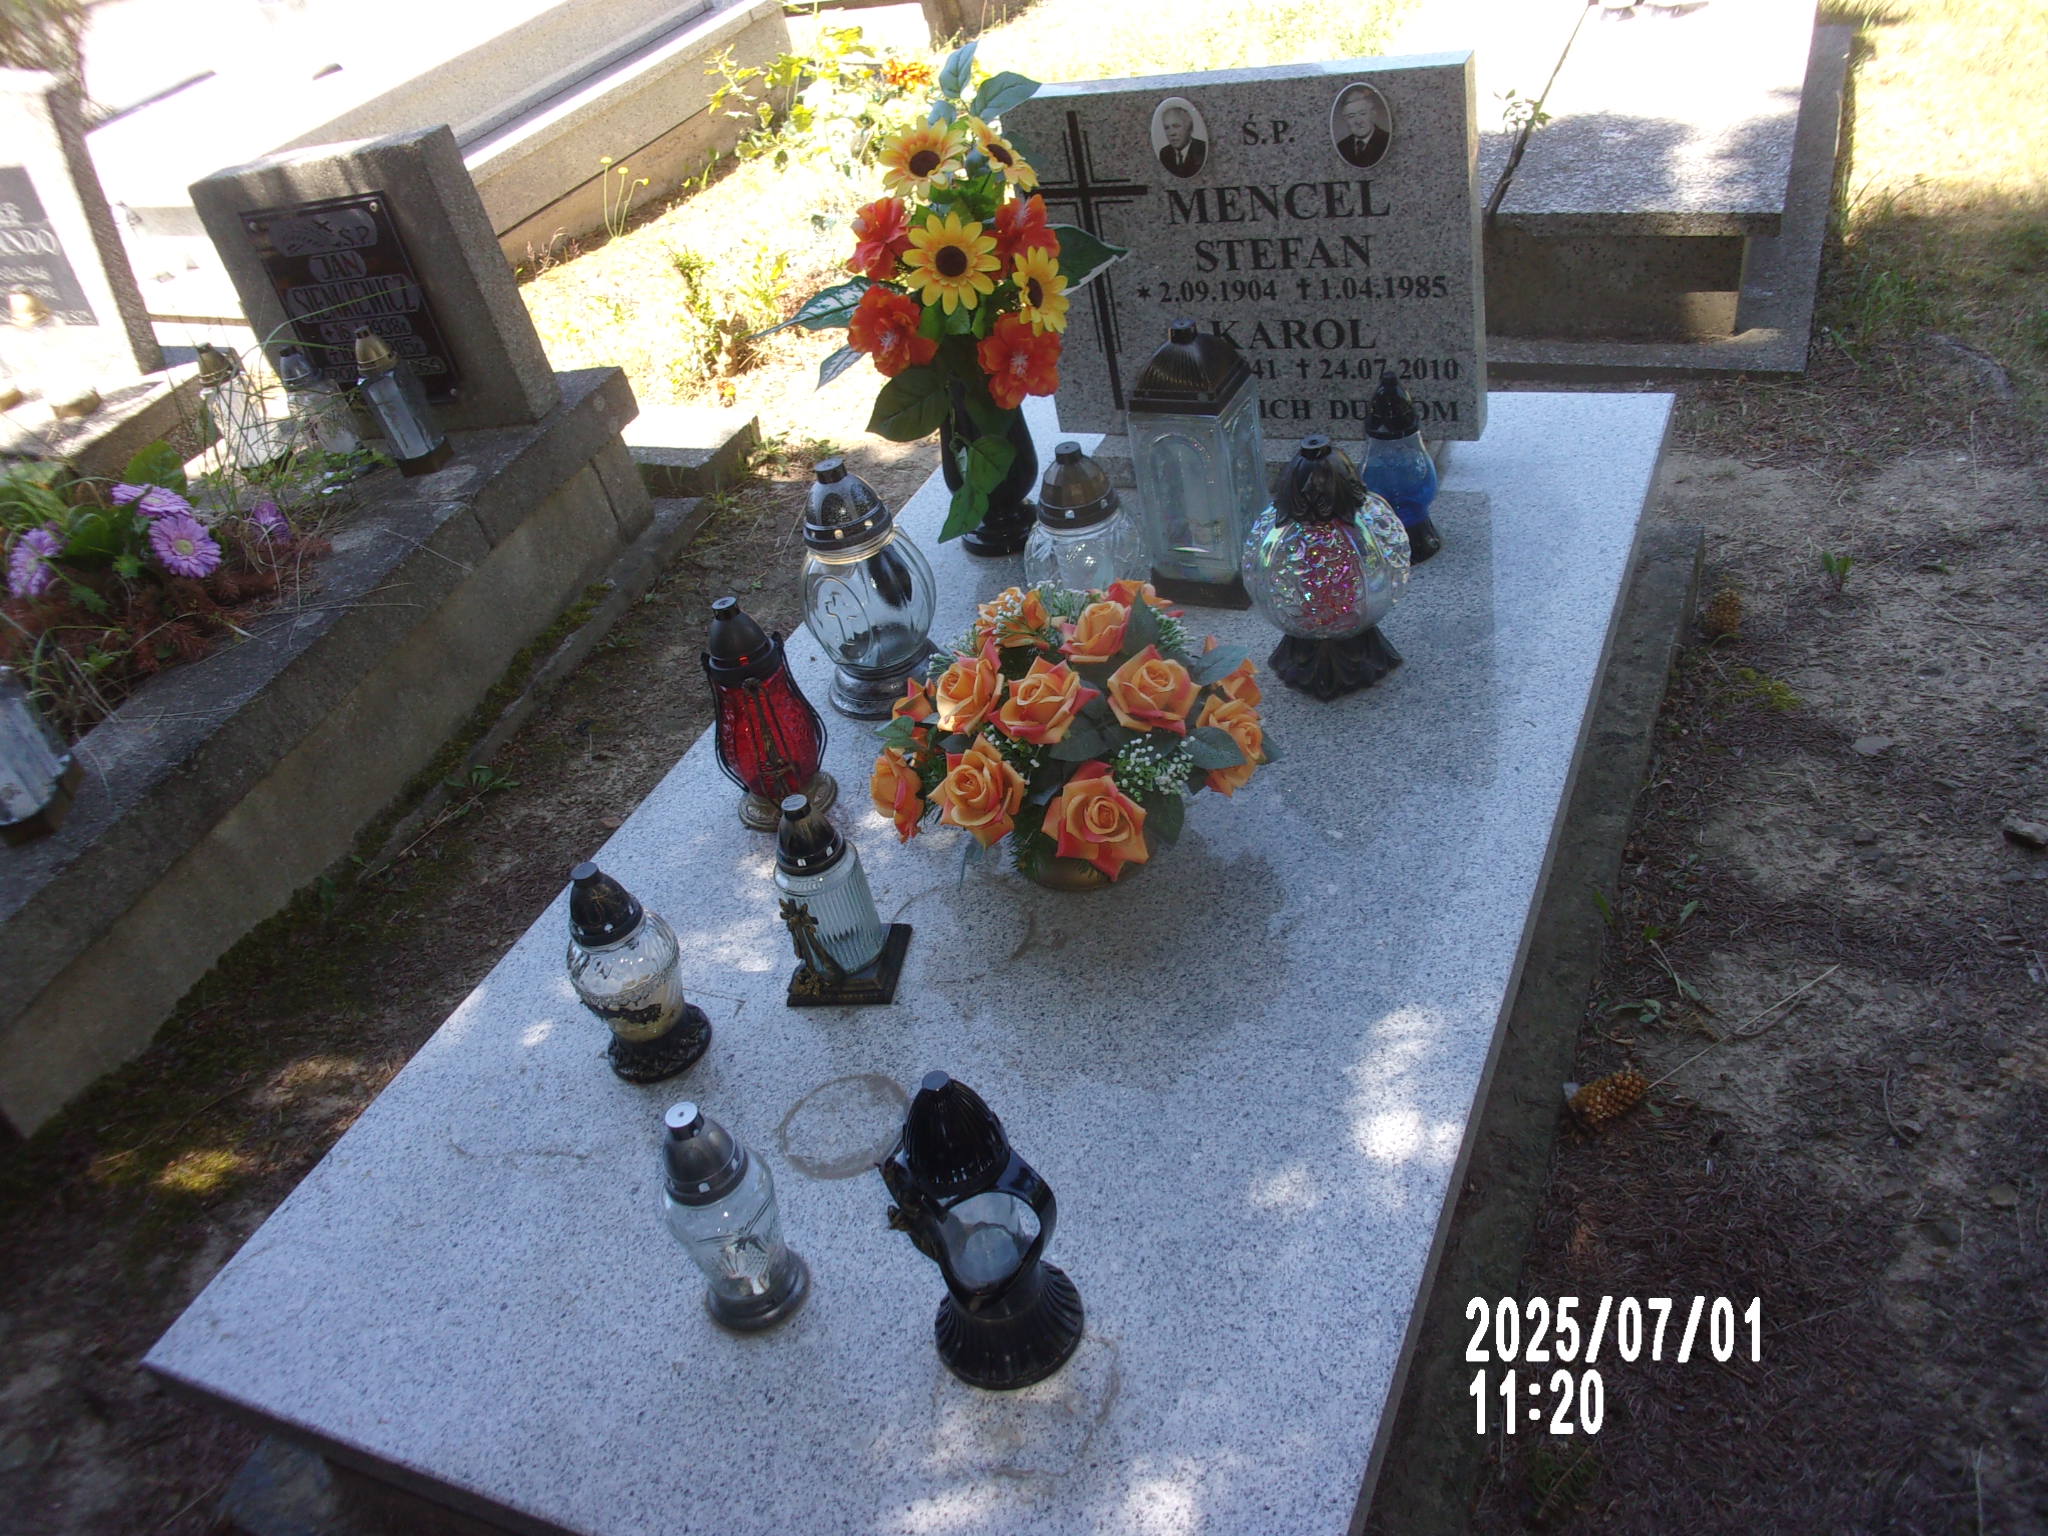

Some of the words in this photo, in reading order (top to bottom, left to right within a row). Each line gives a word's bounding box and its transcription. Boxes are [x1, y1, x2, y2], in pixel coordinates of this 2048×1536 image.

[1165, 179, 1391, 226] MENCEL
[314, 252, 362, 280] JAN
[1194, 233, 1375, 274] STEFAN
[1209, 318, 1378, 351] KAROL
[1319, 357, 1459, 381] 24.072010
[1258, 398, 1311, 421] ICH
[1329, 398, 1459, 422] DUOM
